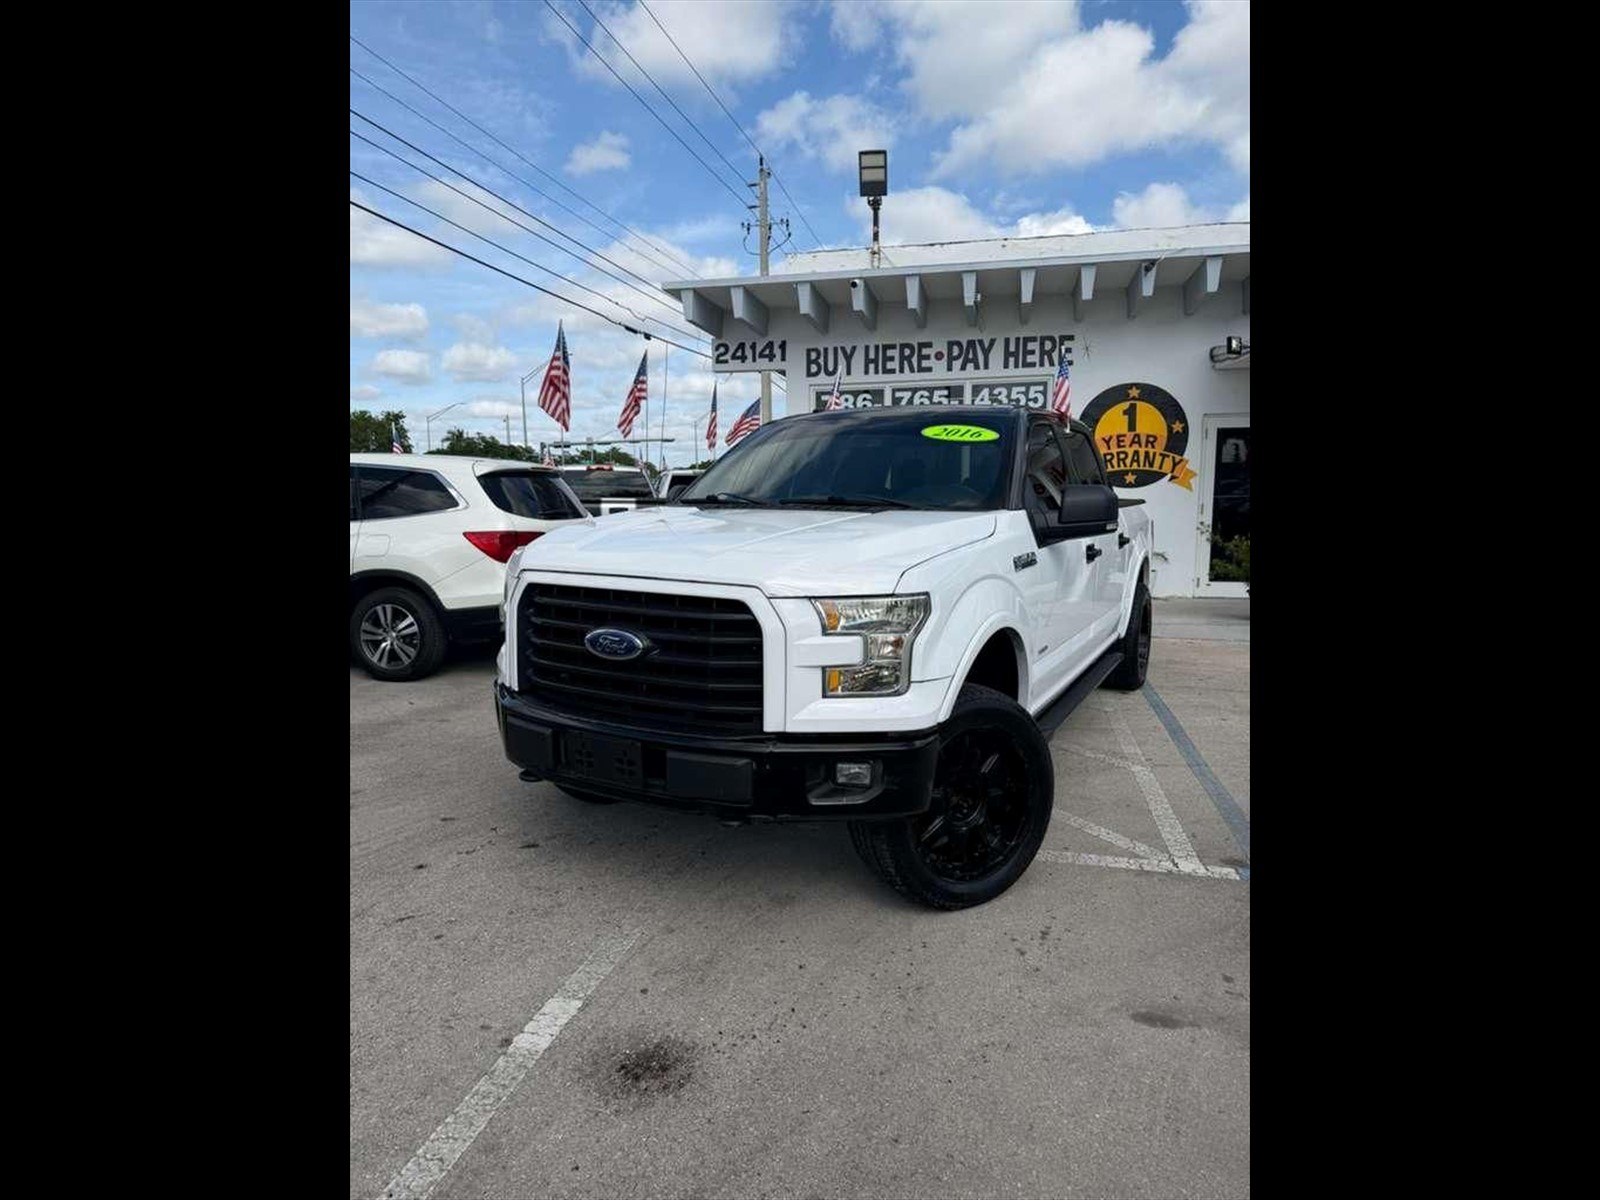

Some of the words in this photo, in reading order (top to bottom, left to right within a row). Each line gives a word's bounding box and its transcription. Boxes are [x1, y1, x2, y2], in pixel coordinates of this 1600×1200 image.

[714, 340, 787, 364] 24141
[806, 345, 857, 378] BUY
[864, 341, 933, 375] HERE
[946, 338, 997, 372] PAY
[1003, 335, 1075, 369] HERE
[974, 385, 1045, 408] 4355
[1122, 402, 1138, 433] 1
[932, 427, 983, 439] 2016
[1102, 434, 1159, 450] YEAR
[1103, 450, 1184, 474] RRANTY
